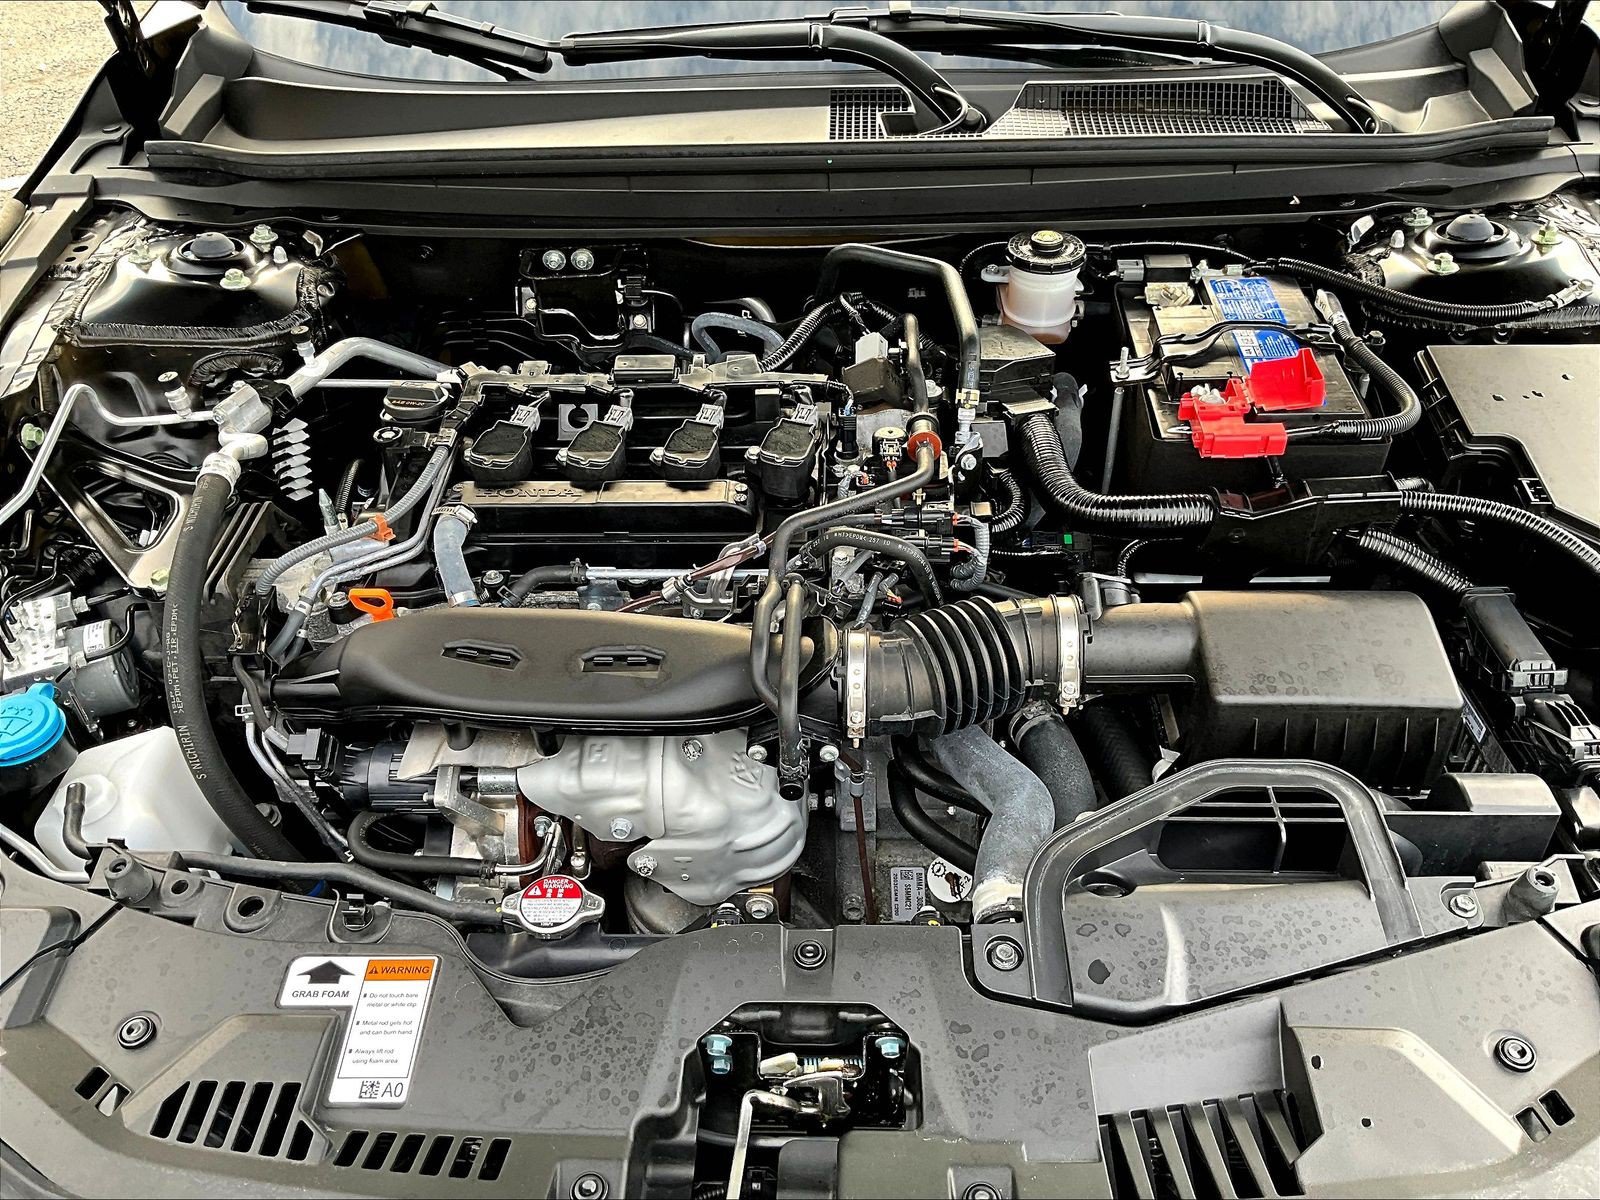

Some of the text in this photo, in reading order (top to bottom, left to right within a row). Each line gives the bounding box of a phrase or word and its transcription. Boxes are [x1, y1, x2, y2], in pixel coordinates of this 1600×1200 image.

[476, 488, 582, 498] HONDA
[177, 725, 203, 770] NICHIRIN
[381, 965, 430, 974] WARNING
[291, 990, 350, 998] GRAB FOAM
